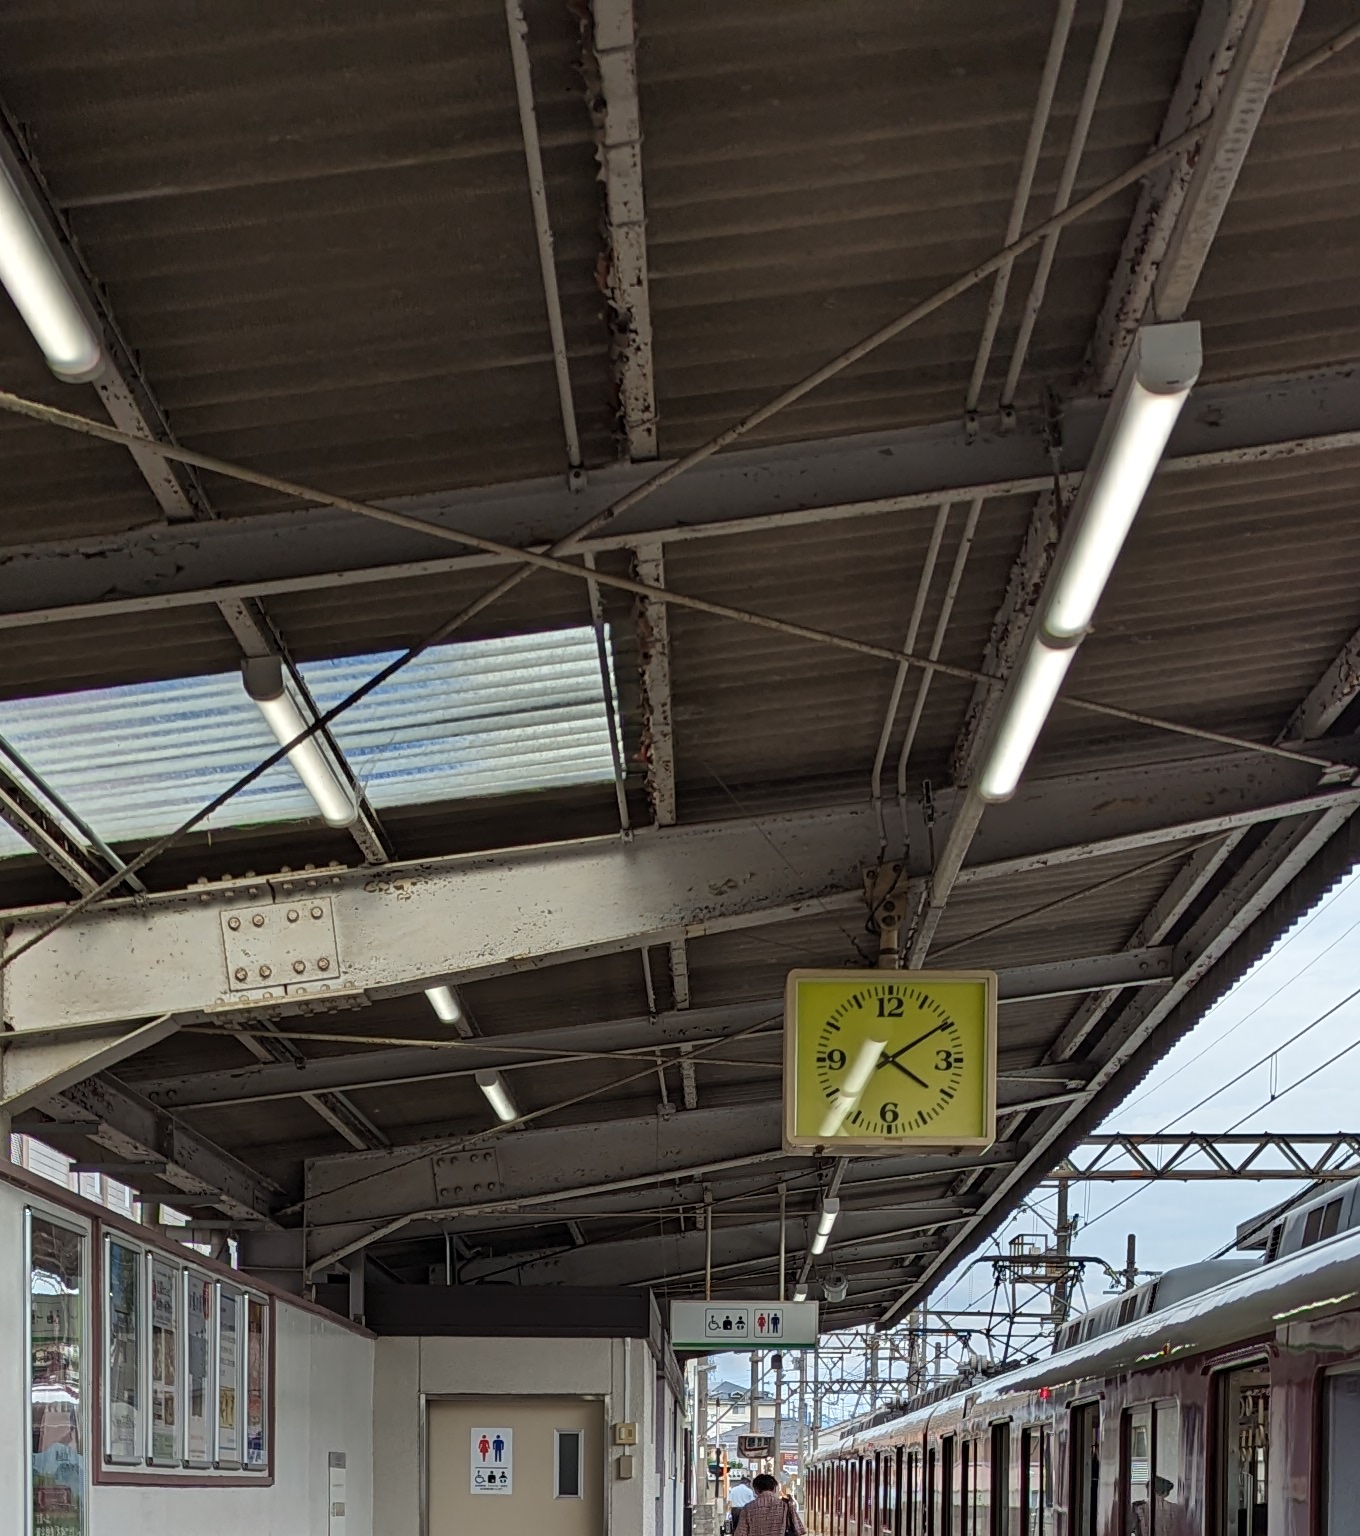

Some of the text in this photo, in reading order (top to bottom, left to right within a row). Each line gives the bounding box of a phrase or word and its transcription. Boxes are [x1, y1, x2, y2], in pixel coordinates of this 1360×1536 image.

[876, 997, 904, 1018] 12
[826, 1048, 847, 1071] 9
[934, 1049, 953, 1072] 3
[879, 1101, 900, 1124] 6
